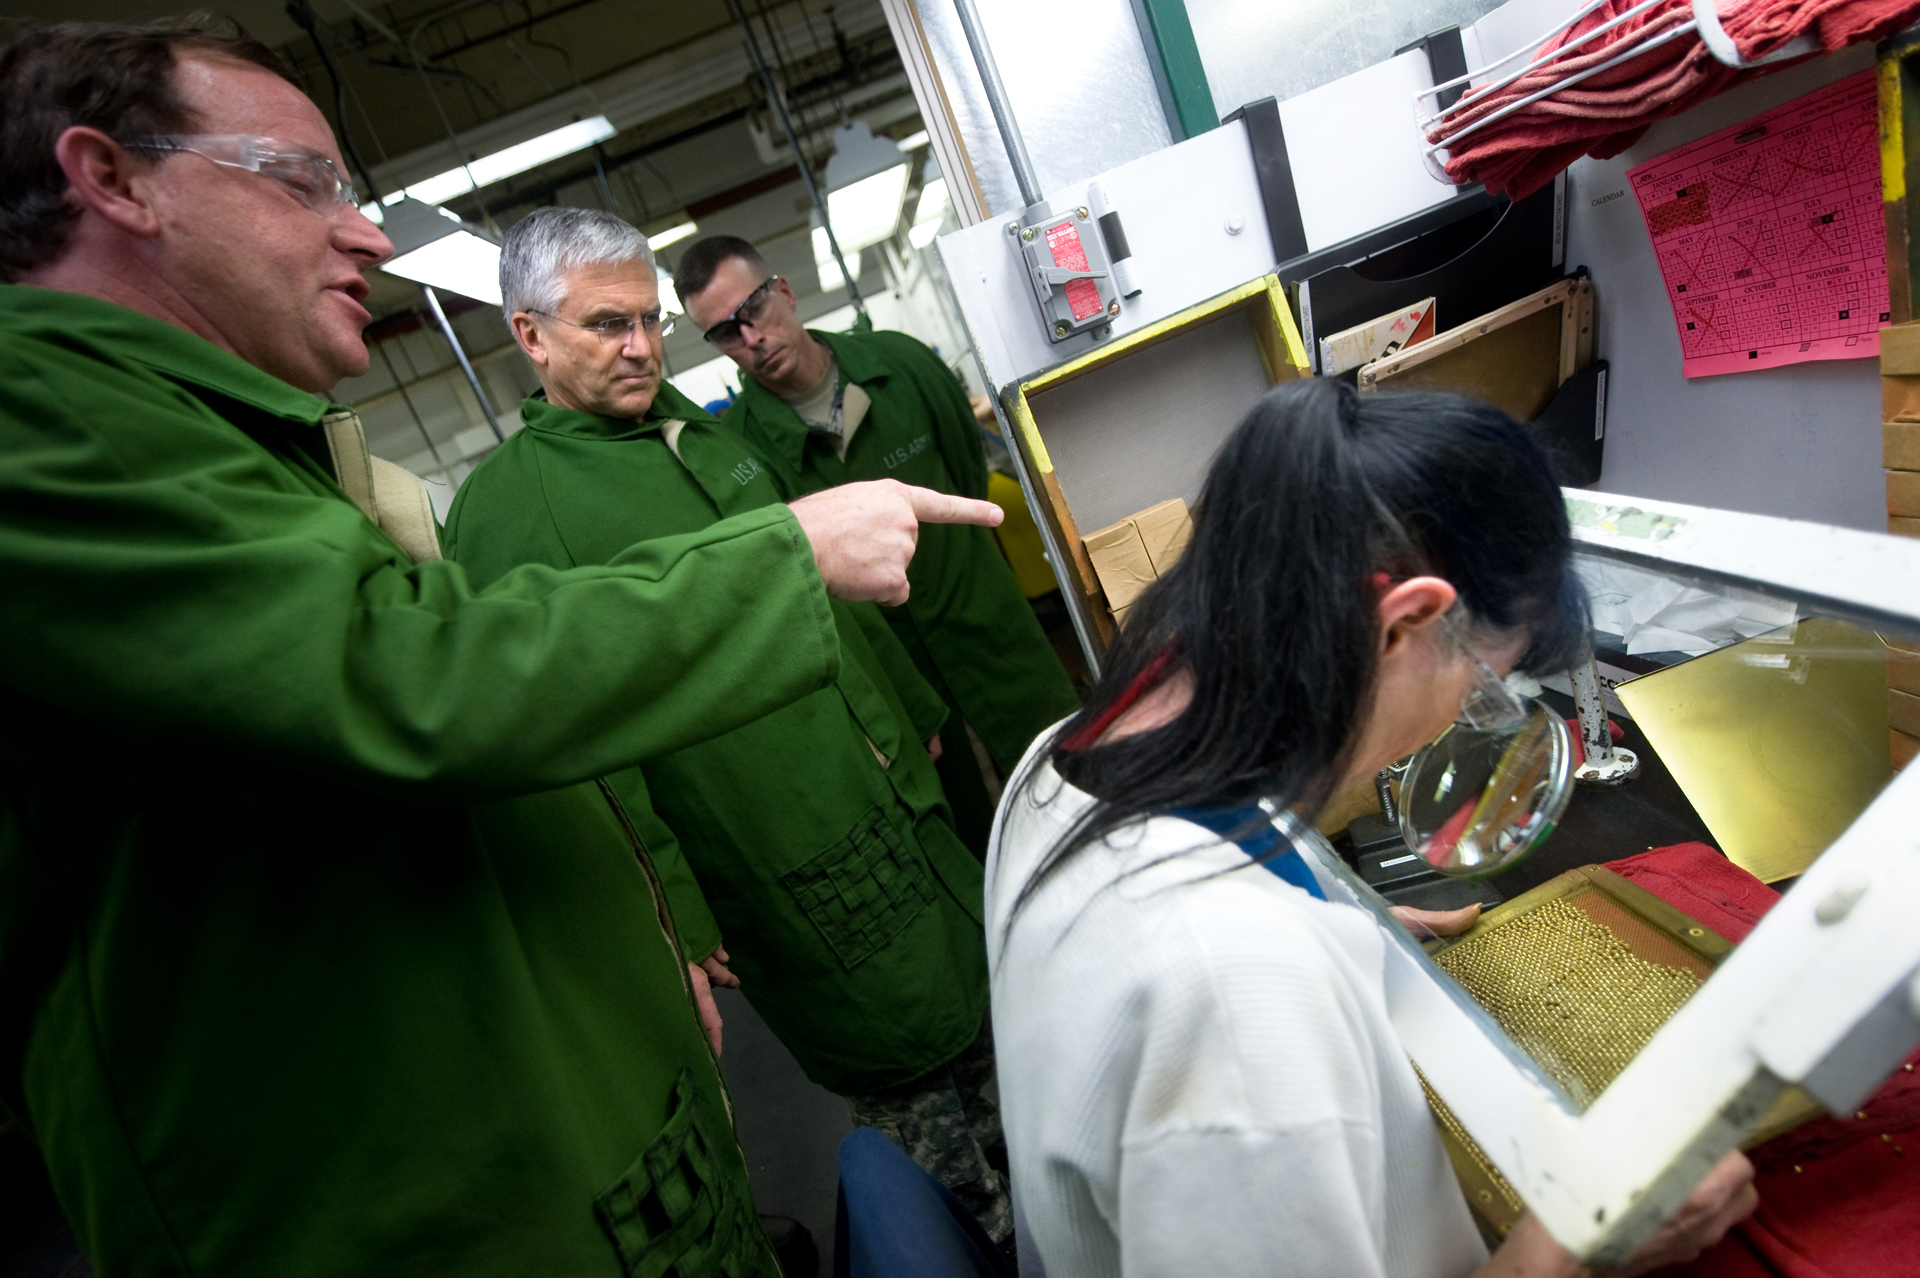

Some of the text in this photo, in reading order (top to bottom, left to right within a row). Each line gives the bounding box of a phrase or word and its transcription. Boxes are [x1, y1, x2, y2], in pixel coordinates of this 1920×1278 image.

[1782, 124, 1812, 141] MARCH
[1712, 148, 1748, 168] FEBRUARY
[1652, 173, 1683, 190] JANUARY
[1591, 190, 1625, 206] CALENDAR
[1804, 198, 1822, 210] JULY
[1736, 218, 1754, 230] JUNE
[1678, 236, 1693, 245] MAY
[1806, 266, 1850, 280] NOVEMBER
[1744, 281, 1777, 294] OCTOBER
[1684, 294, 1719, 307] SEPTEMBER
